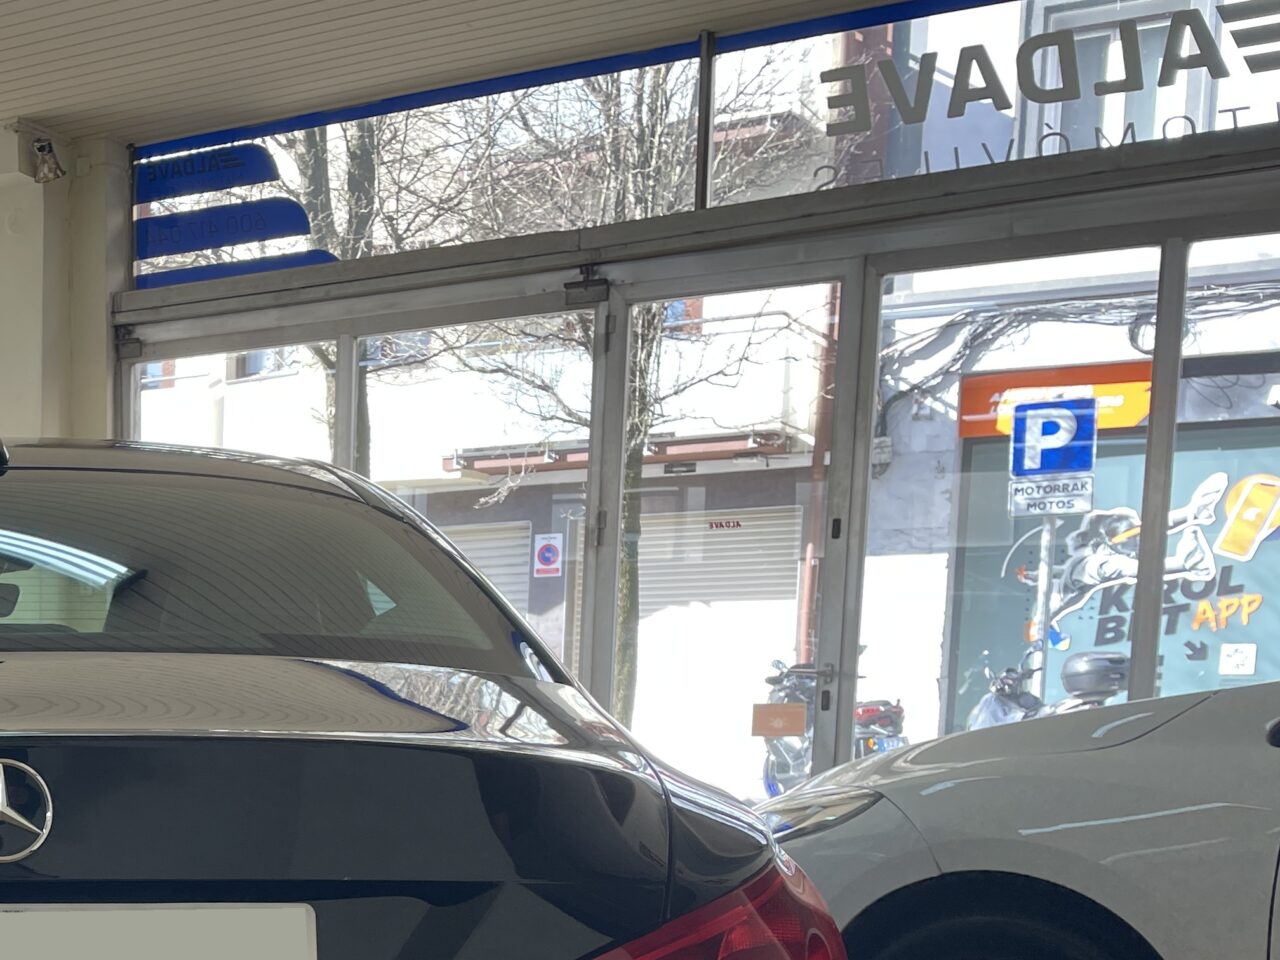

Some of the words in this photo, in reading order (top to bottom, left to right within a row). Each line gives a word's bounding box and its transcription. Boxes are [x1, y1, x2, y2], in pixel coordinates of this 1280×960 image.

[1023, 407, 1078, 470] P
[1013, 481, 1089, 497] MOTORRAK
[1026, 500, 1075, 512] MOTOS
[1094, 603, 1191, 647] BT
[1191, 594, 1263, 632] APP
